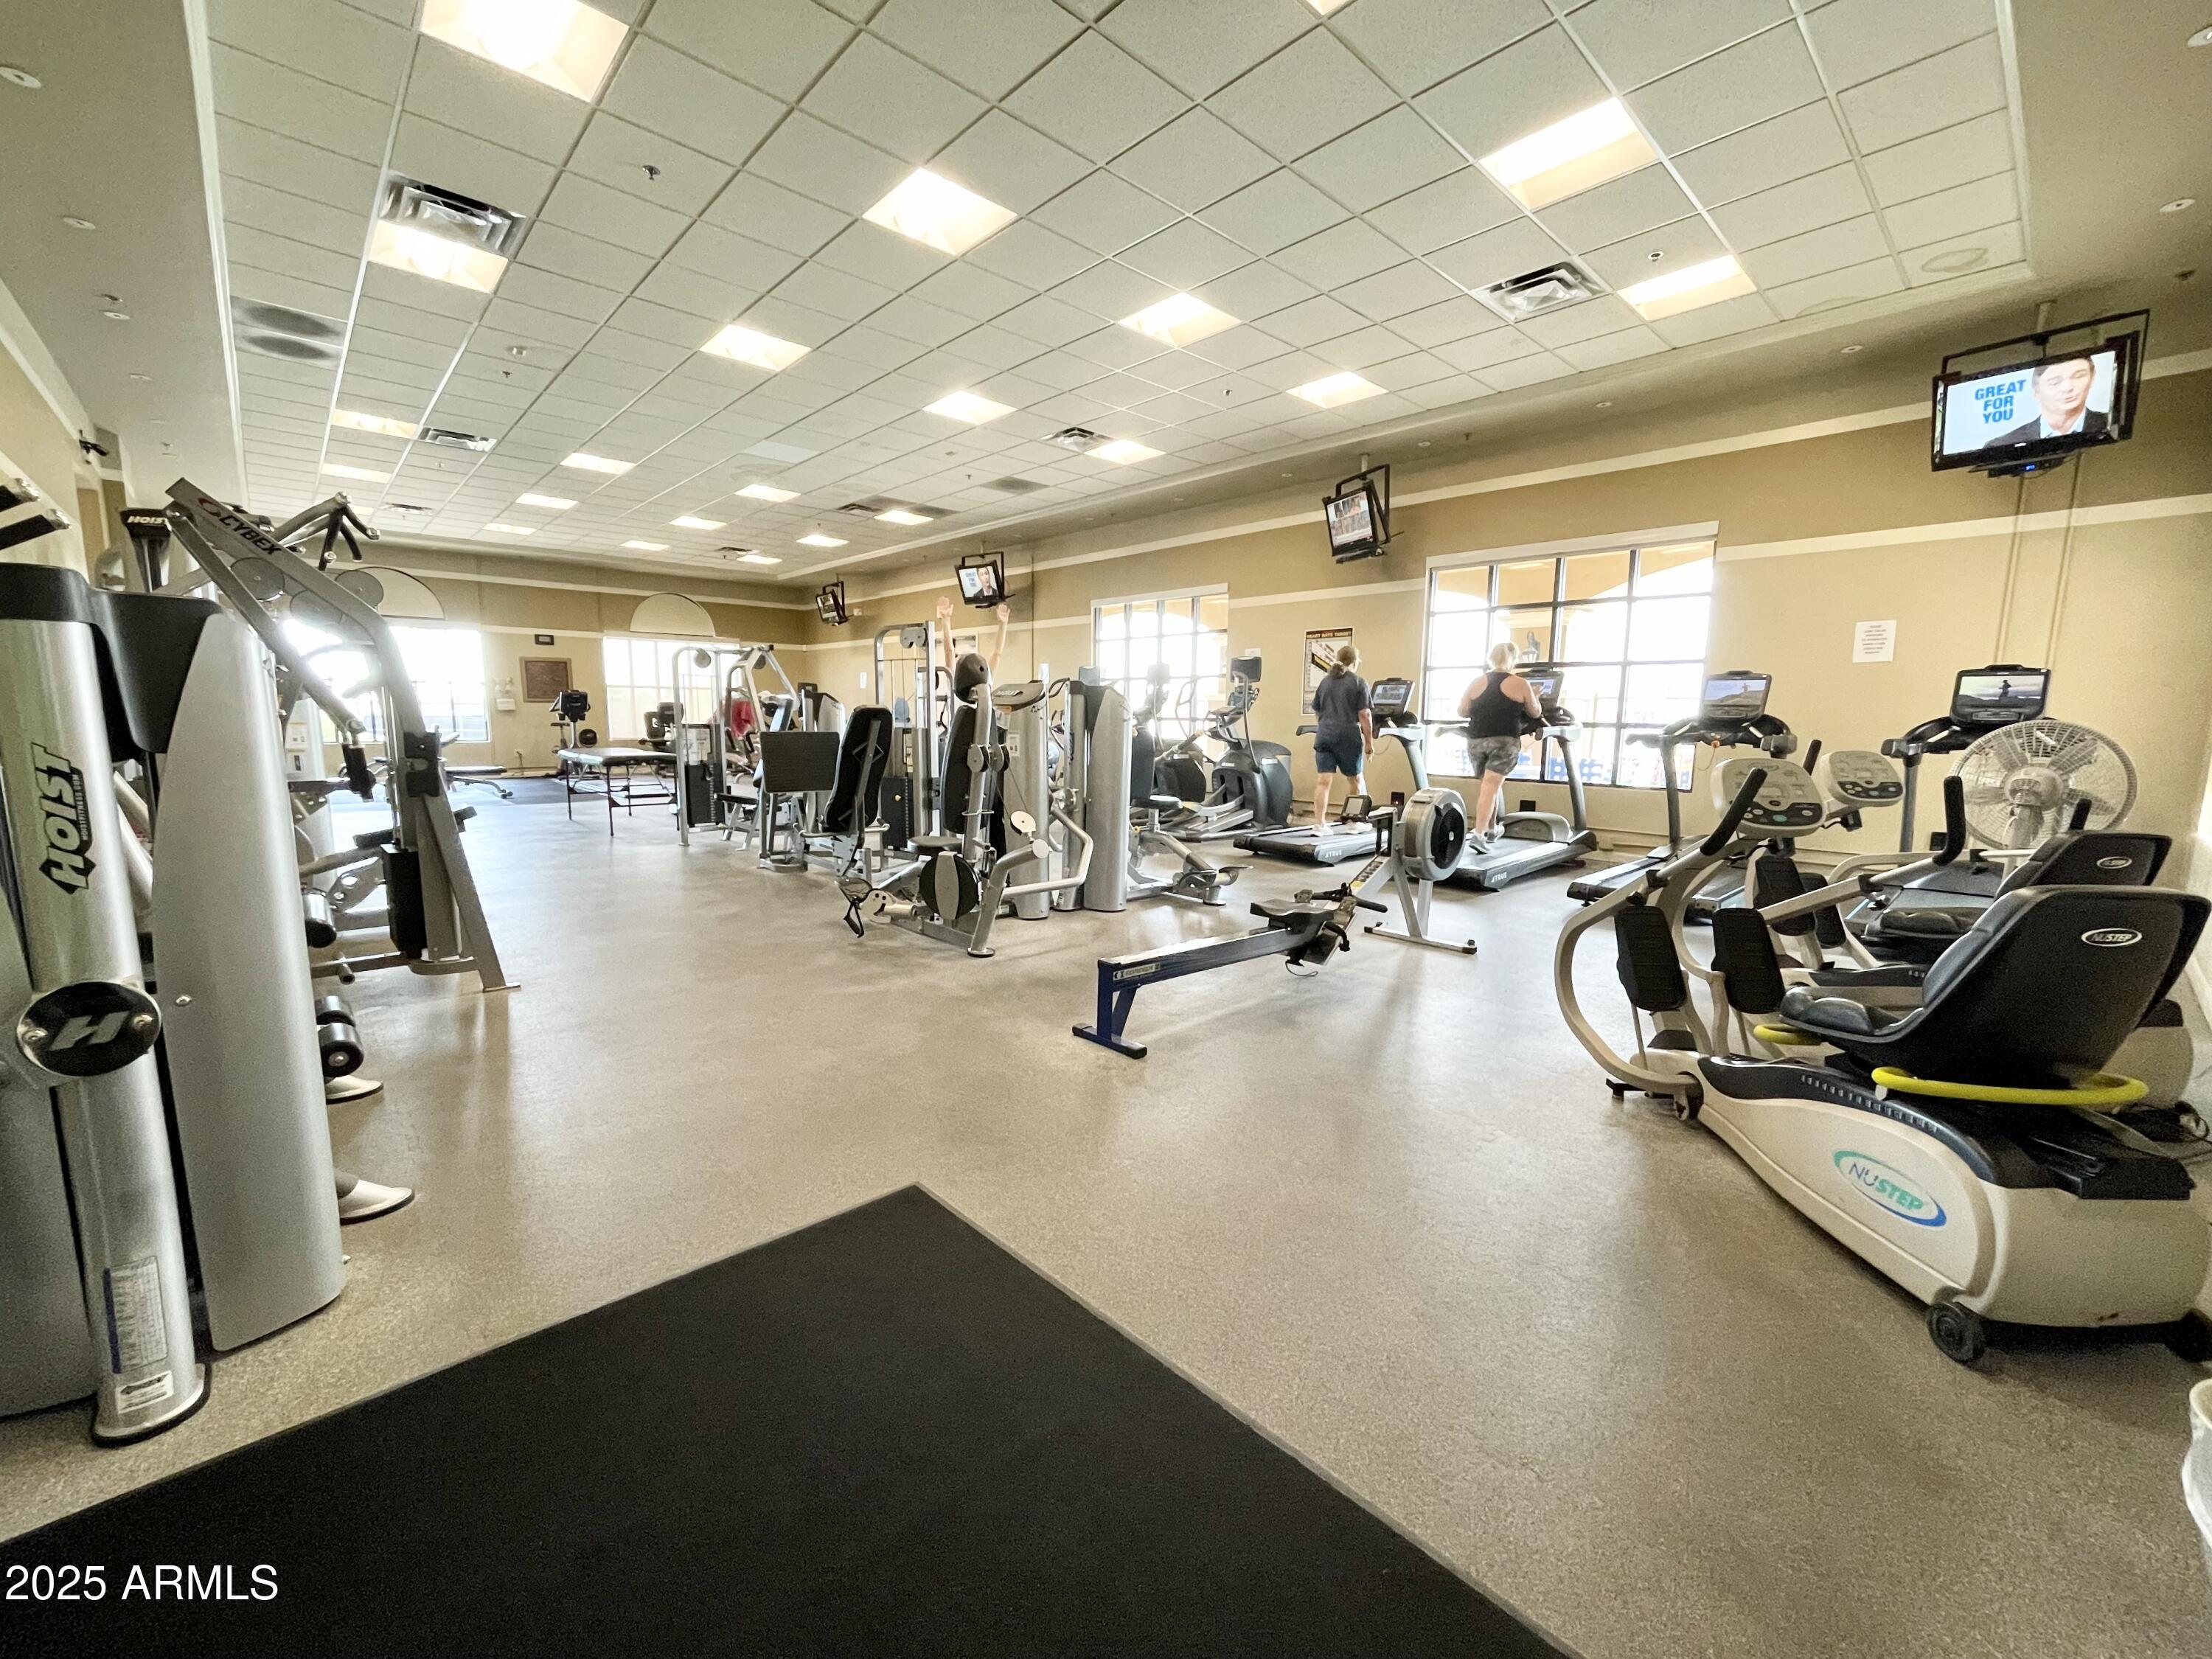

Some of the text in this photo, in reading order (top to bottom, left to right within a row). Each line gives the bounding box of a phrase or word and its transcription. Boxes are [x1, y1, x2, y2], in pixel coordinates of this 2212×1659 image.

[1975, 379, 2027, 400] GREAT
[1983, 395, 2014, 411] FOR
[1983, 408, 2014, 424] YOU
[218, 515, 282, 555] CYBEX
[32, 742, 90, 891] HOIST
[2090, 933, 2132, 942] NUSTEP
[49, 1011, 131, 1051] H
[1848, 1161, 1923, 1209] NUSTEP
